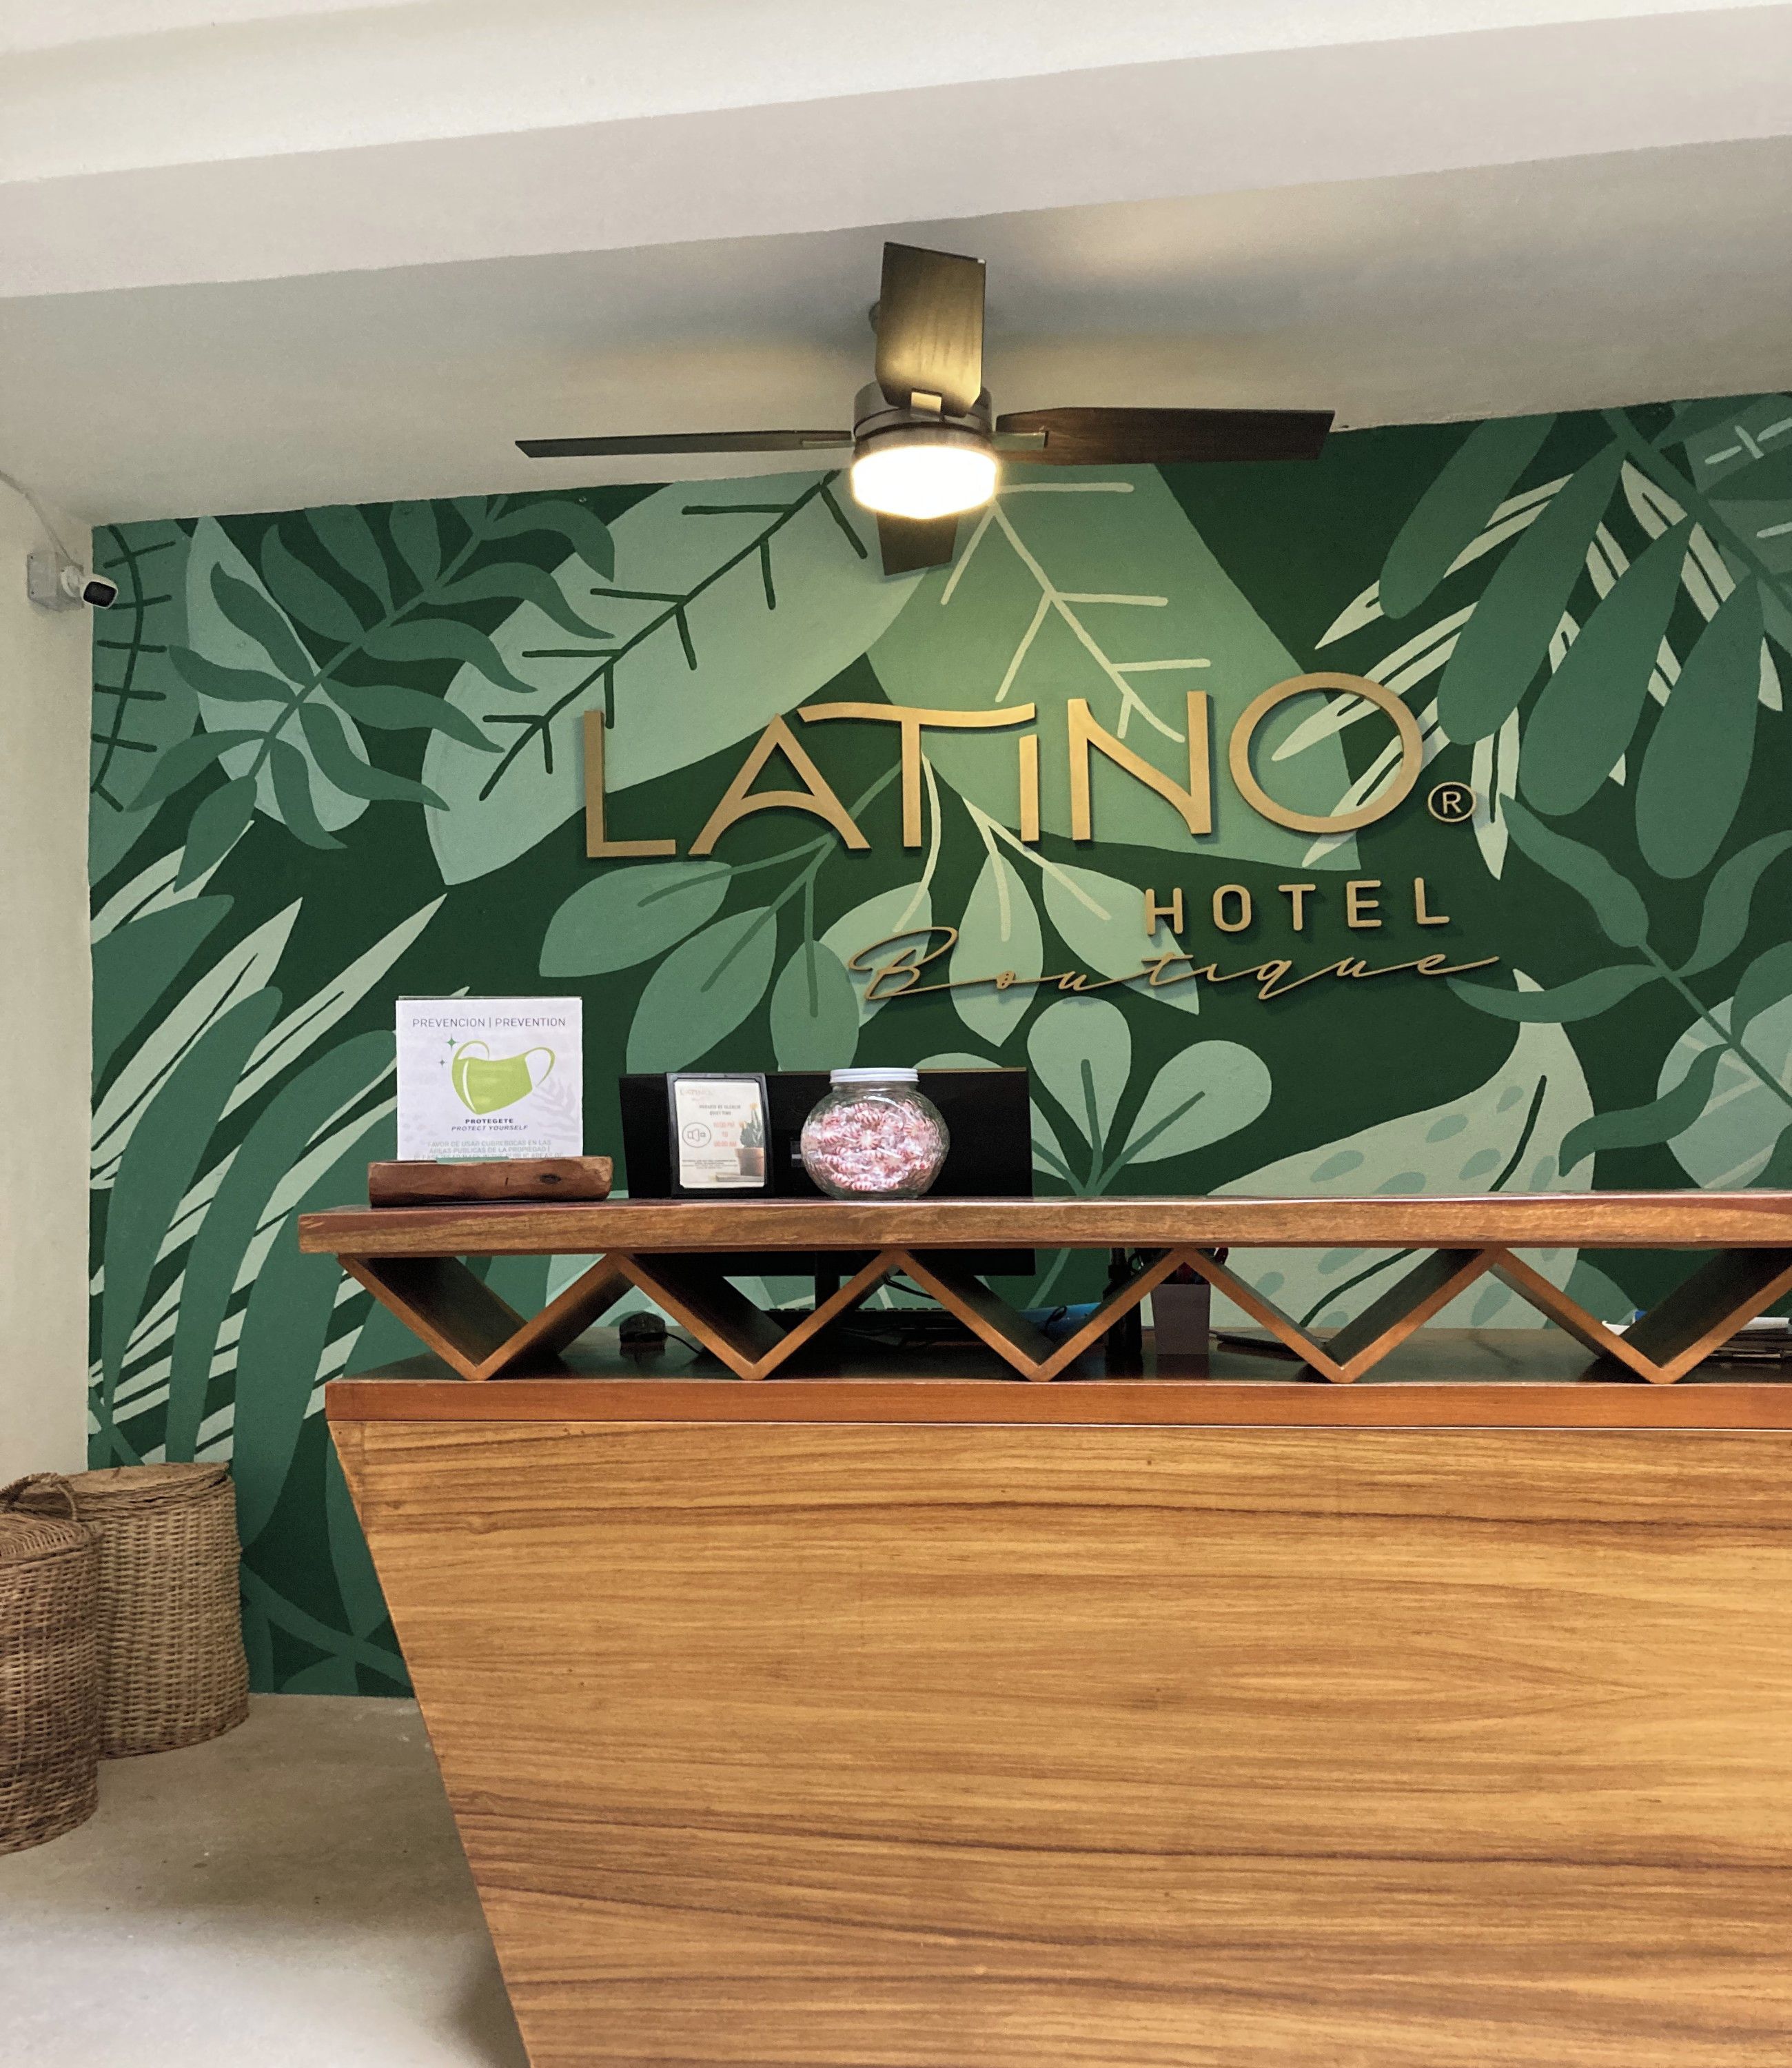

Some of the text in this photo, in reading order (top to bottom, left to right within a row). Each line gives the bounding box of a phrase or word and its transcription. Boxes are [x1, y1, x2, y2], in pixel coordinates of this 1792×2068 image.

[1145, 877, 1451, 935] HOTEL
[848, 926, 1500, 1000] Boutique
[412, 1017, 485, 1028] PREVENCION
[495, 1017, 566, 1027] PREVENTION
